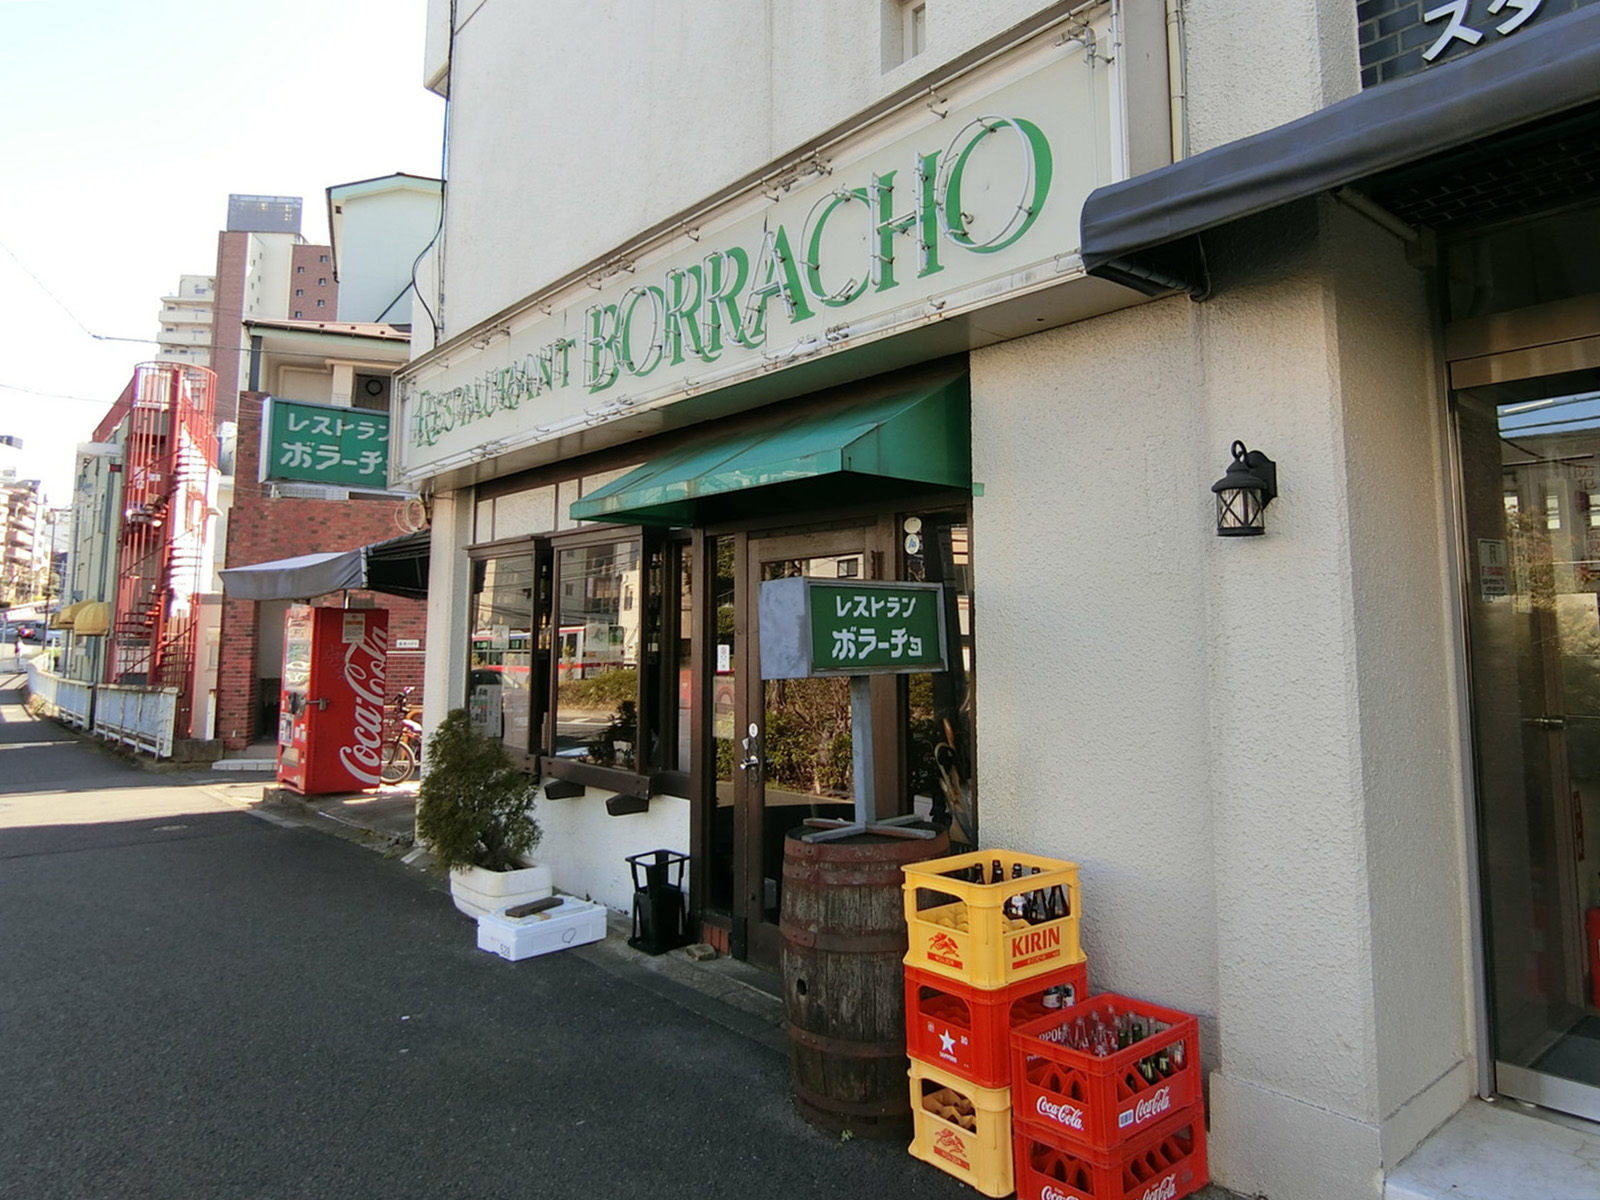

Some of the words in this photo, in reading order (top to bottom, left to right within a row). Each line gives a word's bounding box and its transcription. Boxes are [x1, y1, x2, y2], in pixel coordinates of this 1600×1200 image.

[411, 338, 576, 448] RESTAURANT
[582, 115, 1053, 395] BORRACHO
[836, 595, 917, 618] レストラン
[831, 626, 923, 661] ボラーチョ
[1012, 925, 1060, 958] KIRIN
[1036, 1096, 1084, 1131] Coca-Cola
[1136, 1086, 1171, 1124] Coca-Cola
